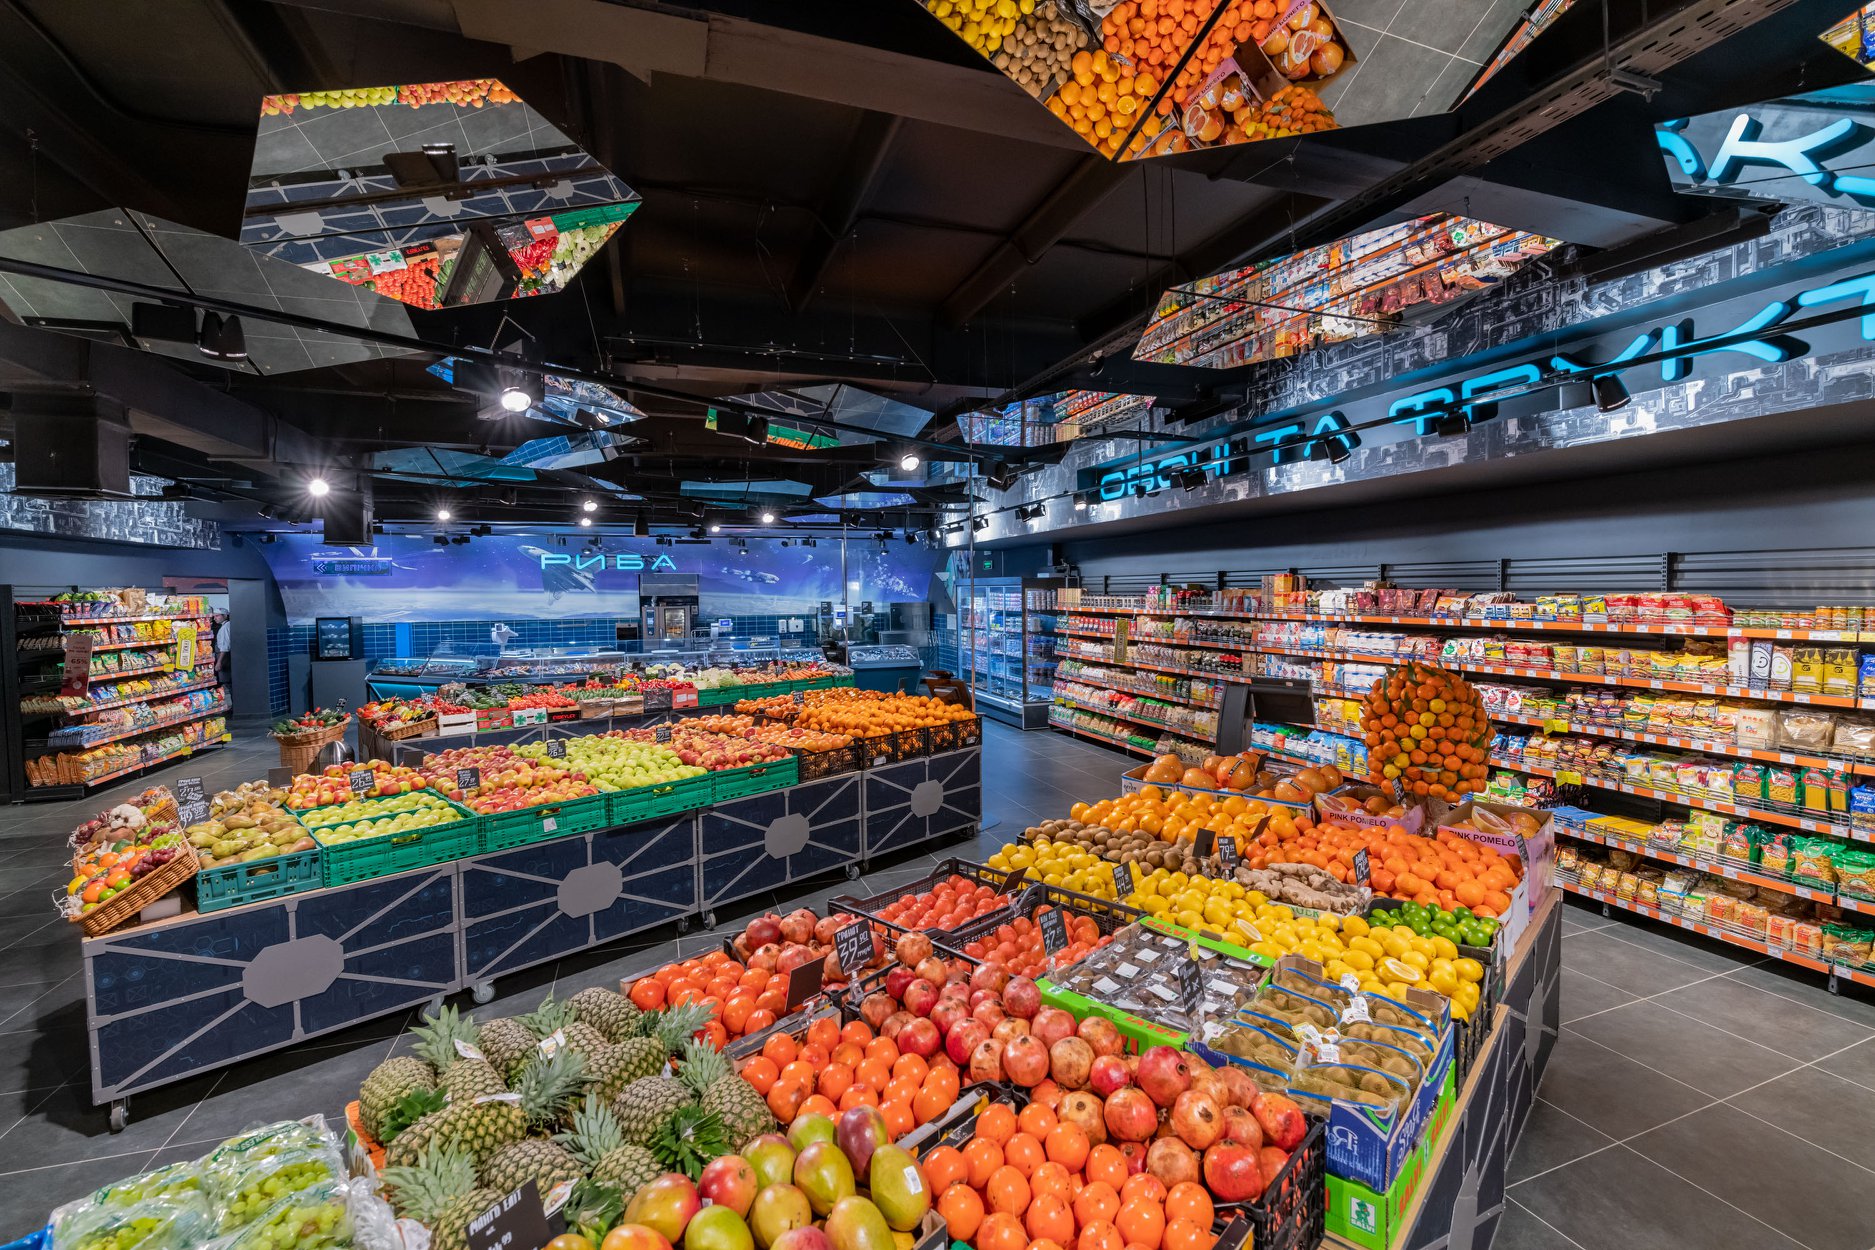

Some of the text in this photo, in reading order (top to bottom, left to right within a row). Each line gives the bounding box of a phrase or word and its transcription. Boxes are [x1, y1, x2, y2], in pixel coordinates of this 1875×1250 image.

[1255, 414, 1350, 465] ТА
[541, 553, 677, 571] РИБА
[351, 778, 365, 789] 26
[1330, 812, 1387, 828] PINK POMELO
[1473, 834, 1516, 848] POMELO
[1219, 845, 1230, 861] 79
[836, 924, 860, 943] ГРАНАТ
[1145, 920, 1189, 939] SALVI
[838, 937, 858, 968] 39
